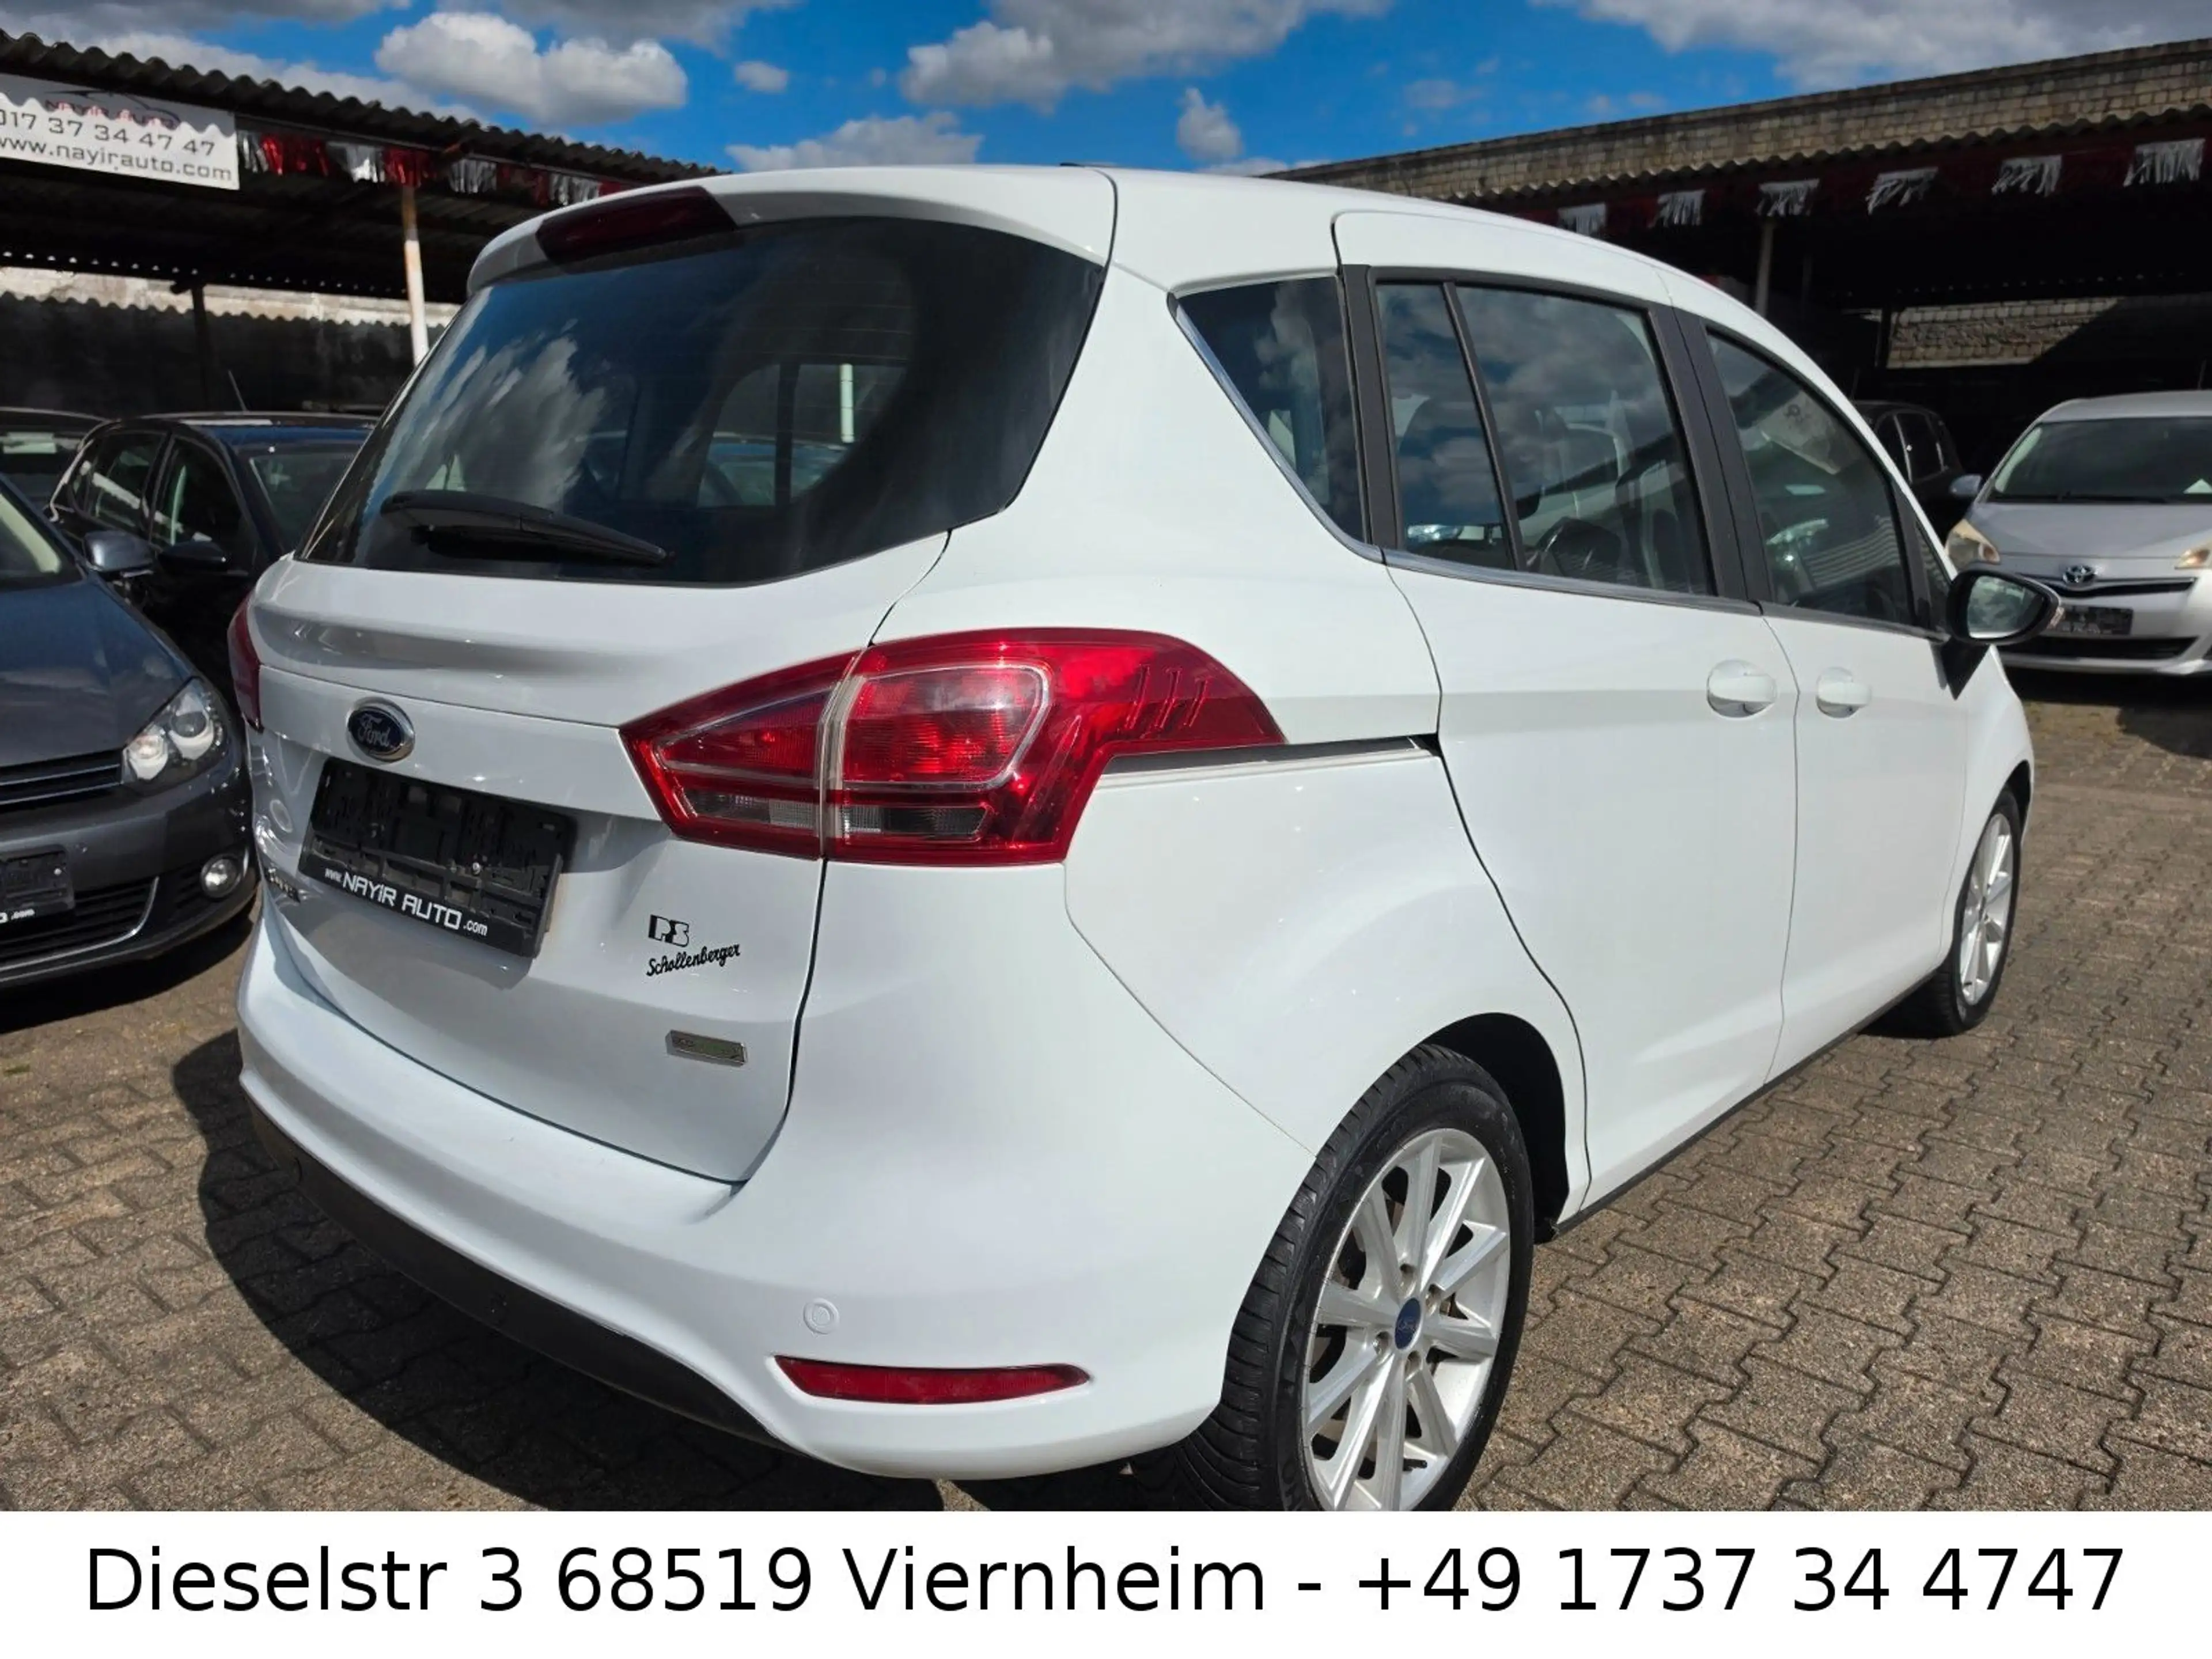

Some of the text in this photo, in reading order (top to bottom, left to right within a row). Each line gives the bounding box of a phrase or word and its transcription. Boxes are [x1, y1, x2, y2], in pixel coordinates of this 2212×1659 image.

[48, 118, 82, 137] 37
[95, 124, 128, 143] 34
[139, 132, 172, 150] 47
[182, 138, 215, 156] 47
[357, 713, 391, 747] Ford
[402, 893, 462, 930] AUTO
[646, 943, 740, 976] Schollenberger
